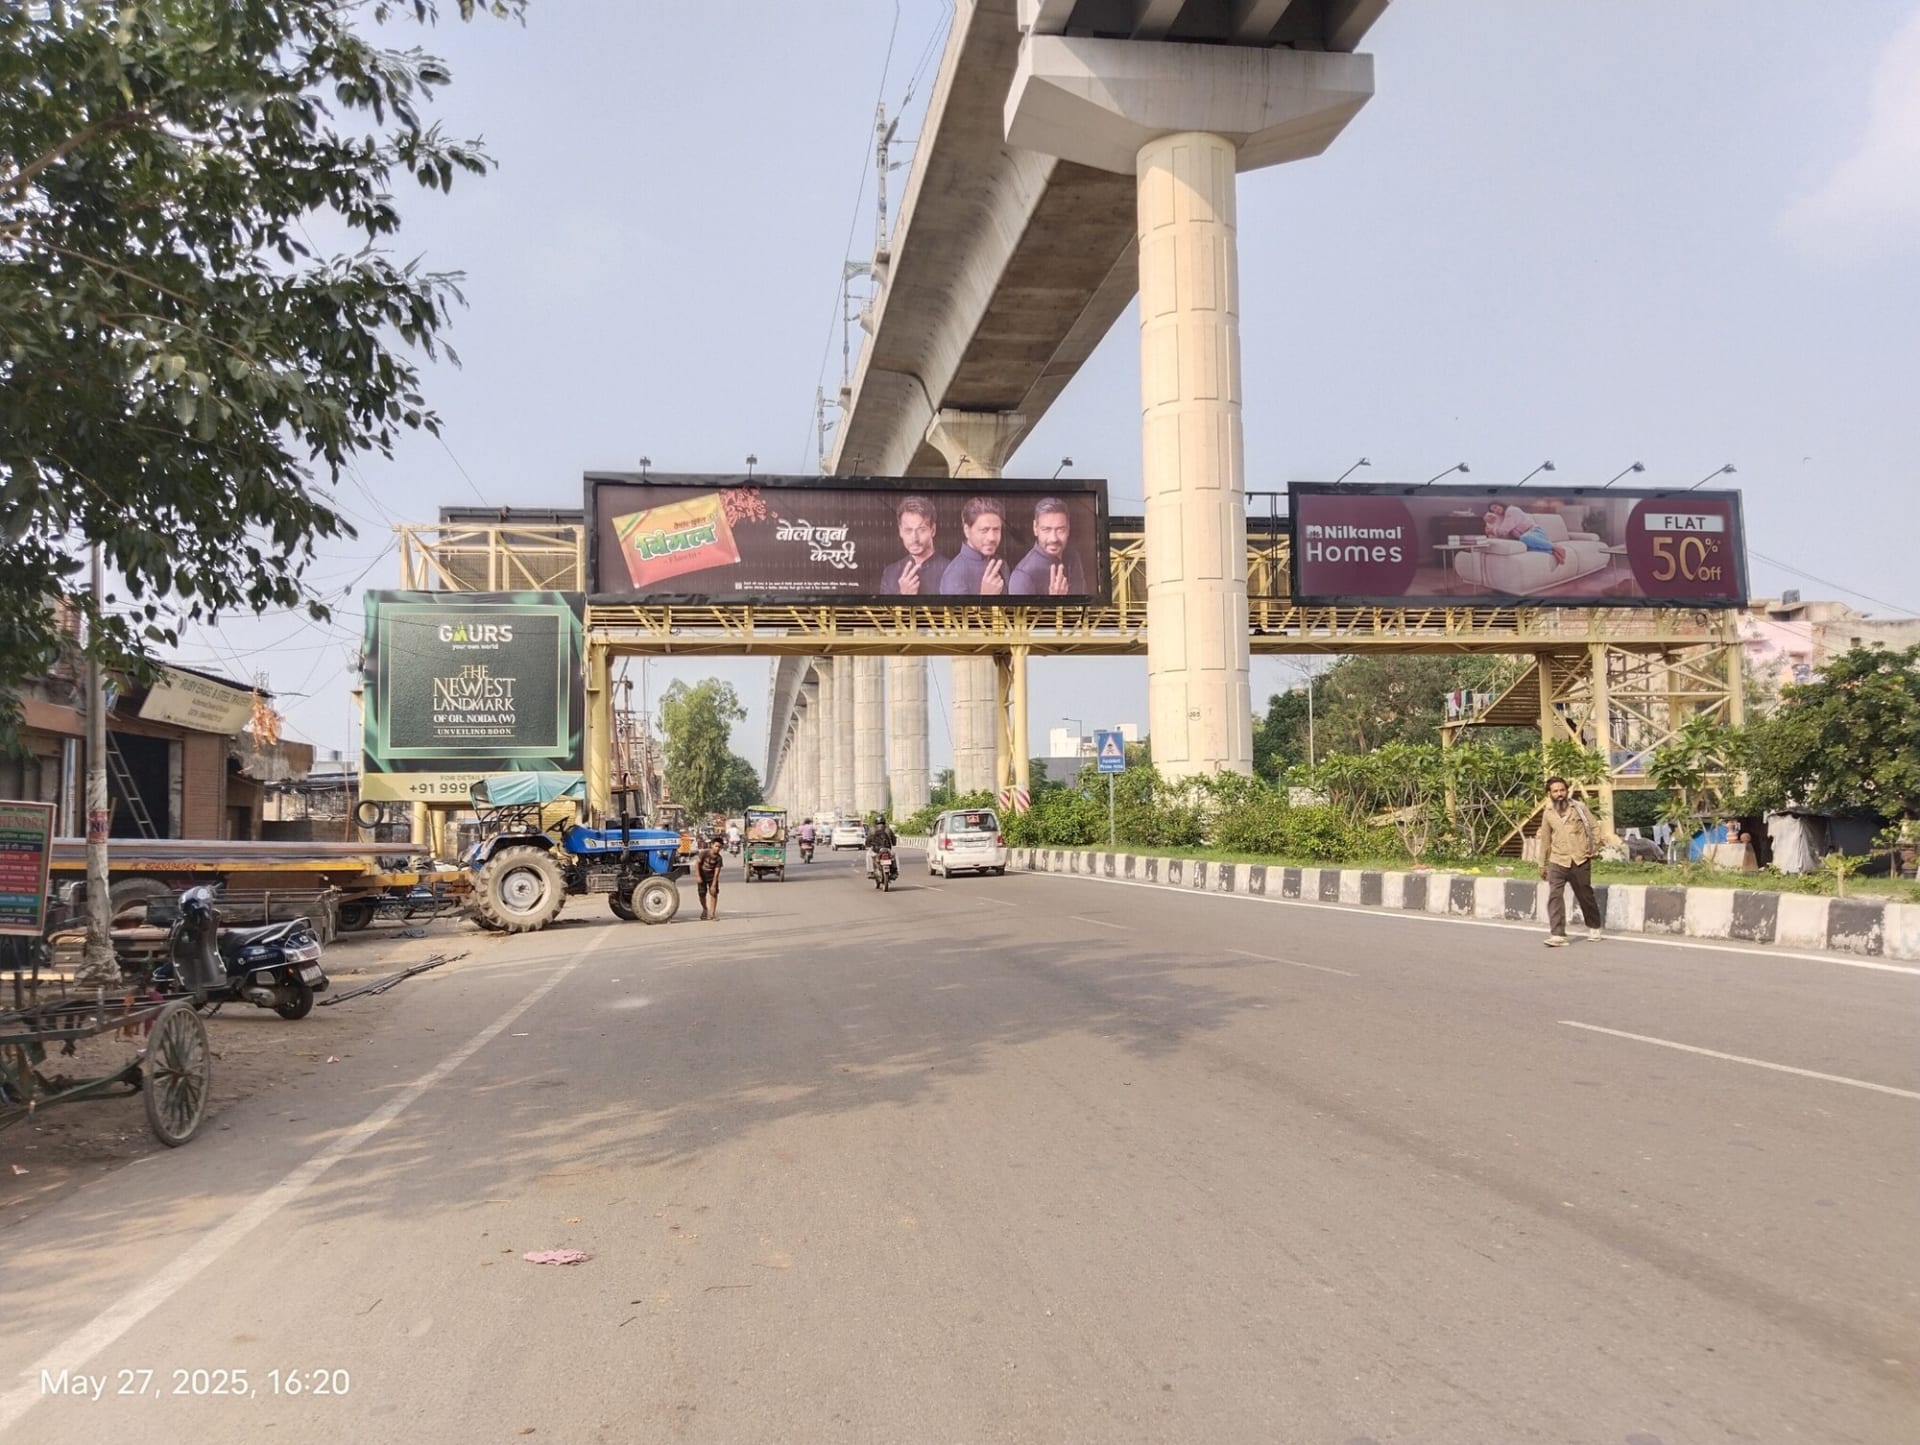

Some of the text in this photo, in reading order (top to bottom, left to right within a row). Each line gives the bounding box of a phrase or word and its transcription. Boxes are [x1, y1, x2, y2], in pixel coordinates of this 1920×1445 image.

[775, 518, 815, 541] बोलो
[1664, 515, 1707, 530] FLAT
[1324, 525, 1403, 540] Nilkamal
[808, 541, 859, 570] केसरी
[1306, 541, 1403, 563] Homes
[1698, 566, 1722, 582] Off
[439, 622, 514, 643] GAURS
[460, 664, 489, 679] THE
[432, 677, 517, 698] NEWEST
[433, 697, 516, 712] LANDMARK
[433, 713, 448, 723] OF
[466, 713, 498, 723] NOIDA
[498, 713, 516, 724] (W)
[409, 782, 475, 794] +91 999
